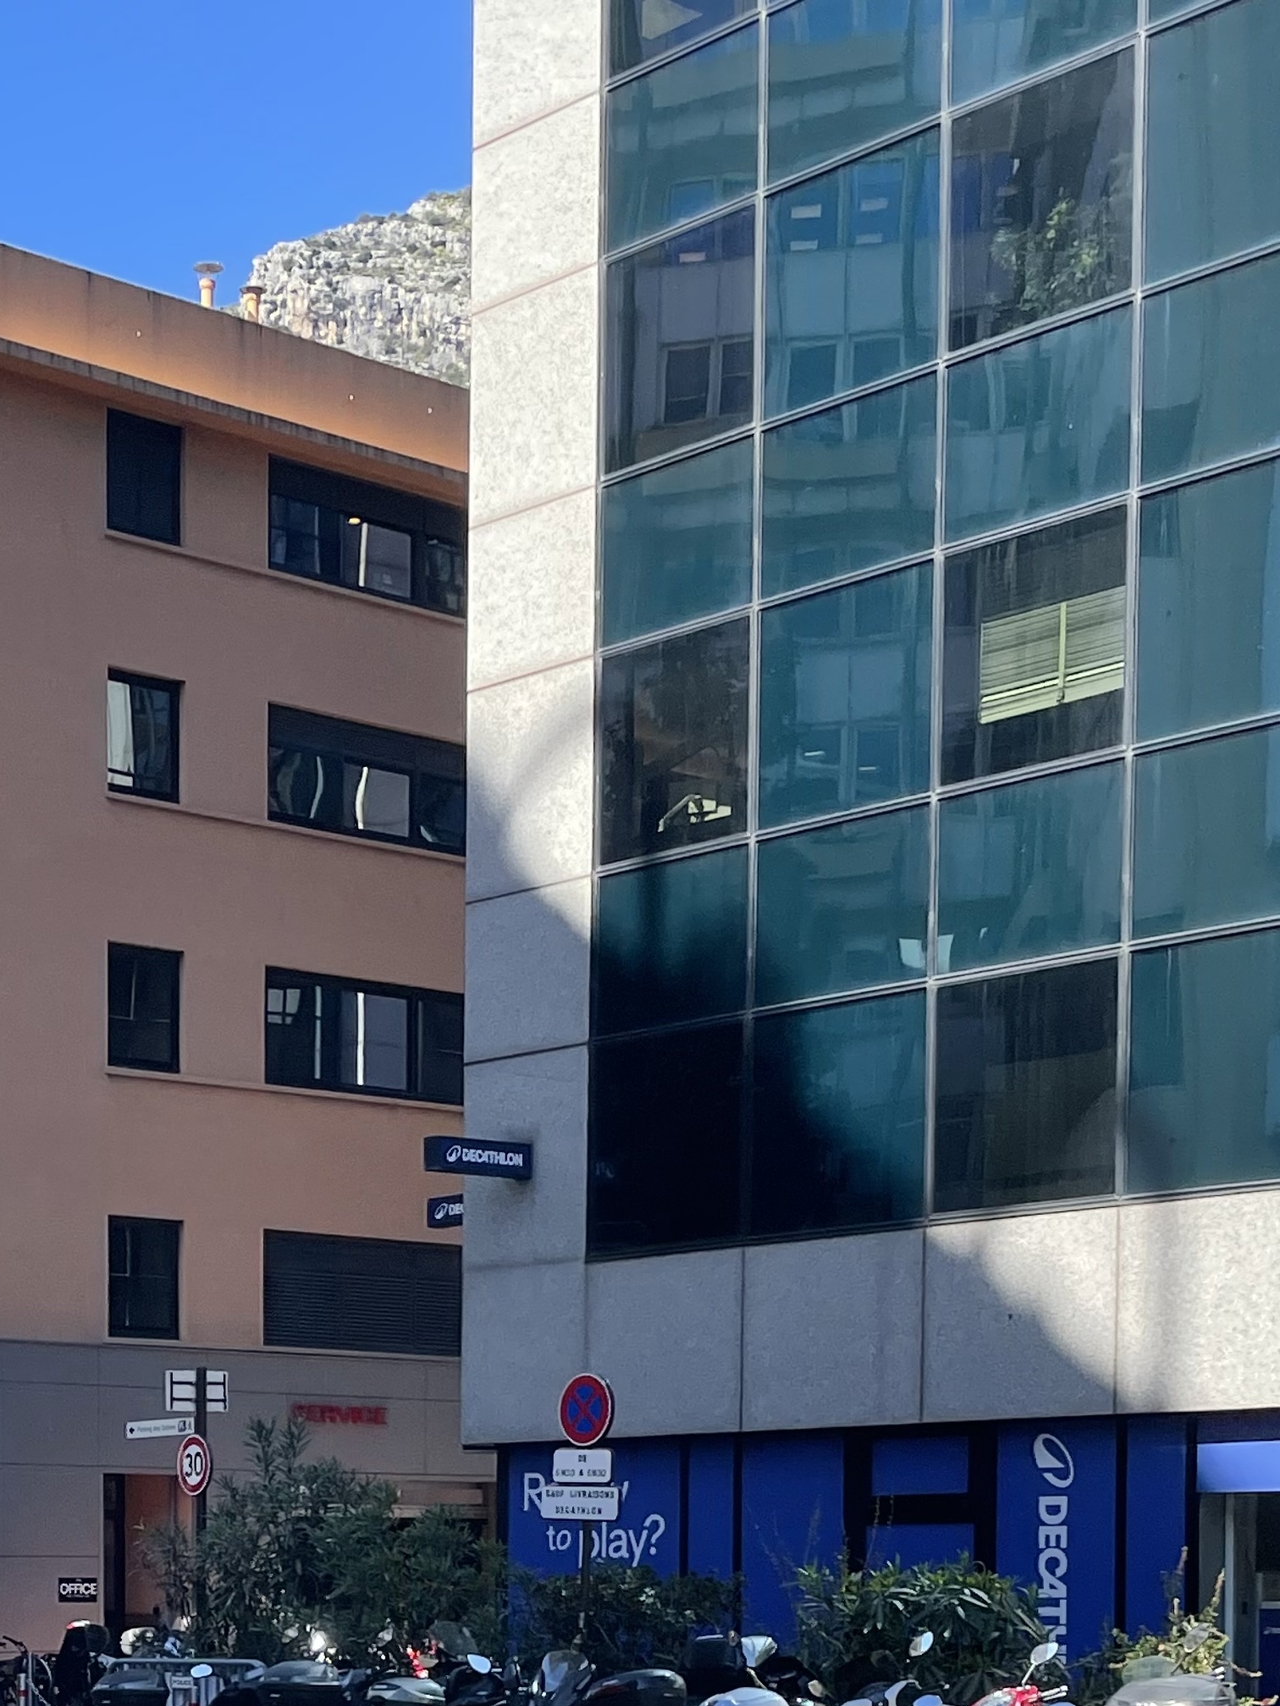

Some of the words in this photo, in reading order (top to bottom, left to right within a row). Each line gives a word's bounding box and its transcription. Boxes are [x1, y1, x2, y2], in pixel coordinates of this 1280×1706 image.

[462, 1148, 523, 1167] DECATHLON
[185, 1452, 203, 1477] 30
[546, 1526, 572, 1551] to
[578, 1514, 665, 1568] play?
[60, 1583, 97, 1595] OFFICE
